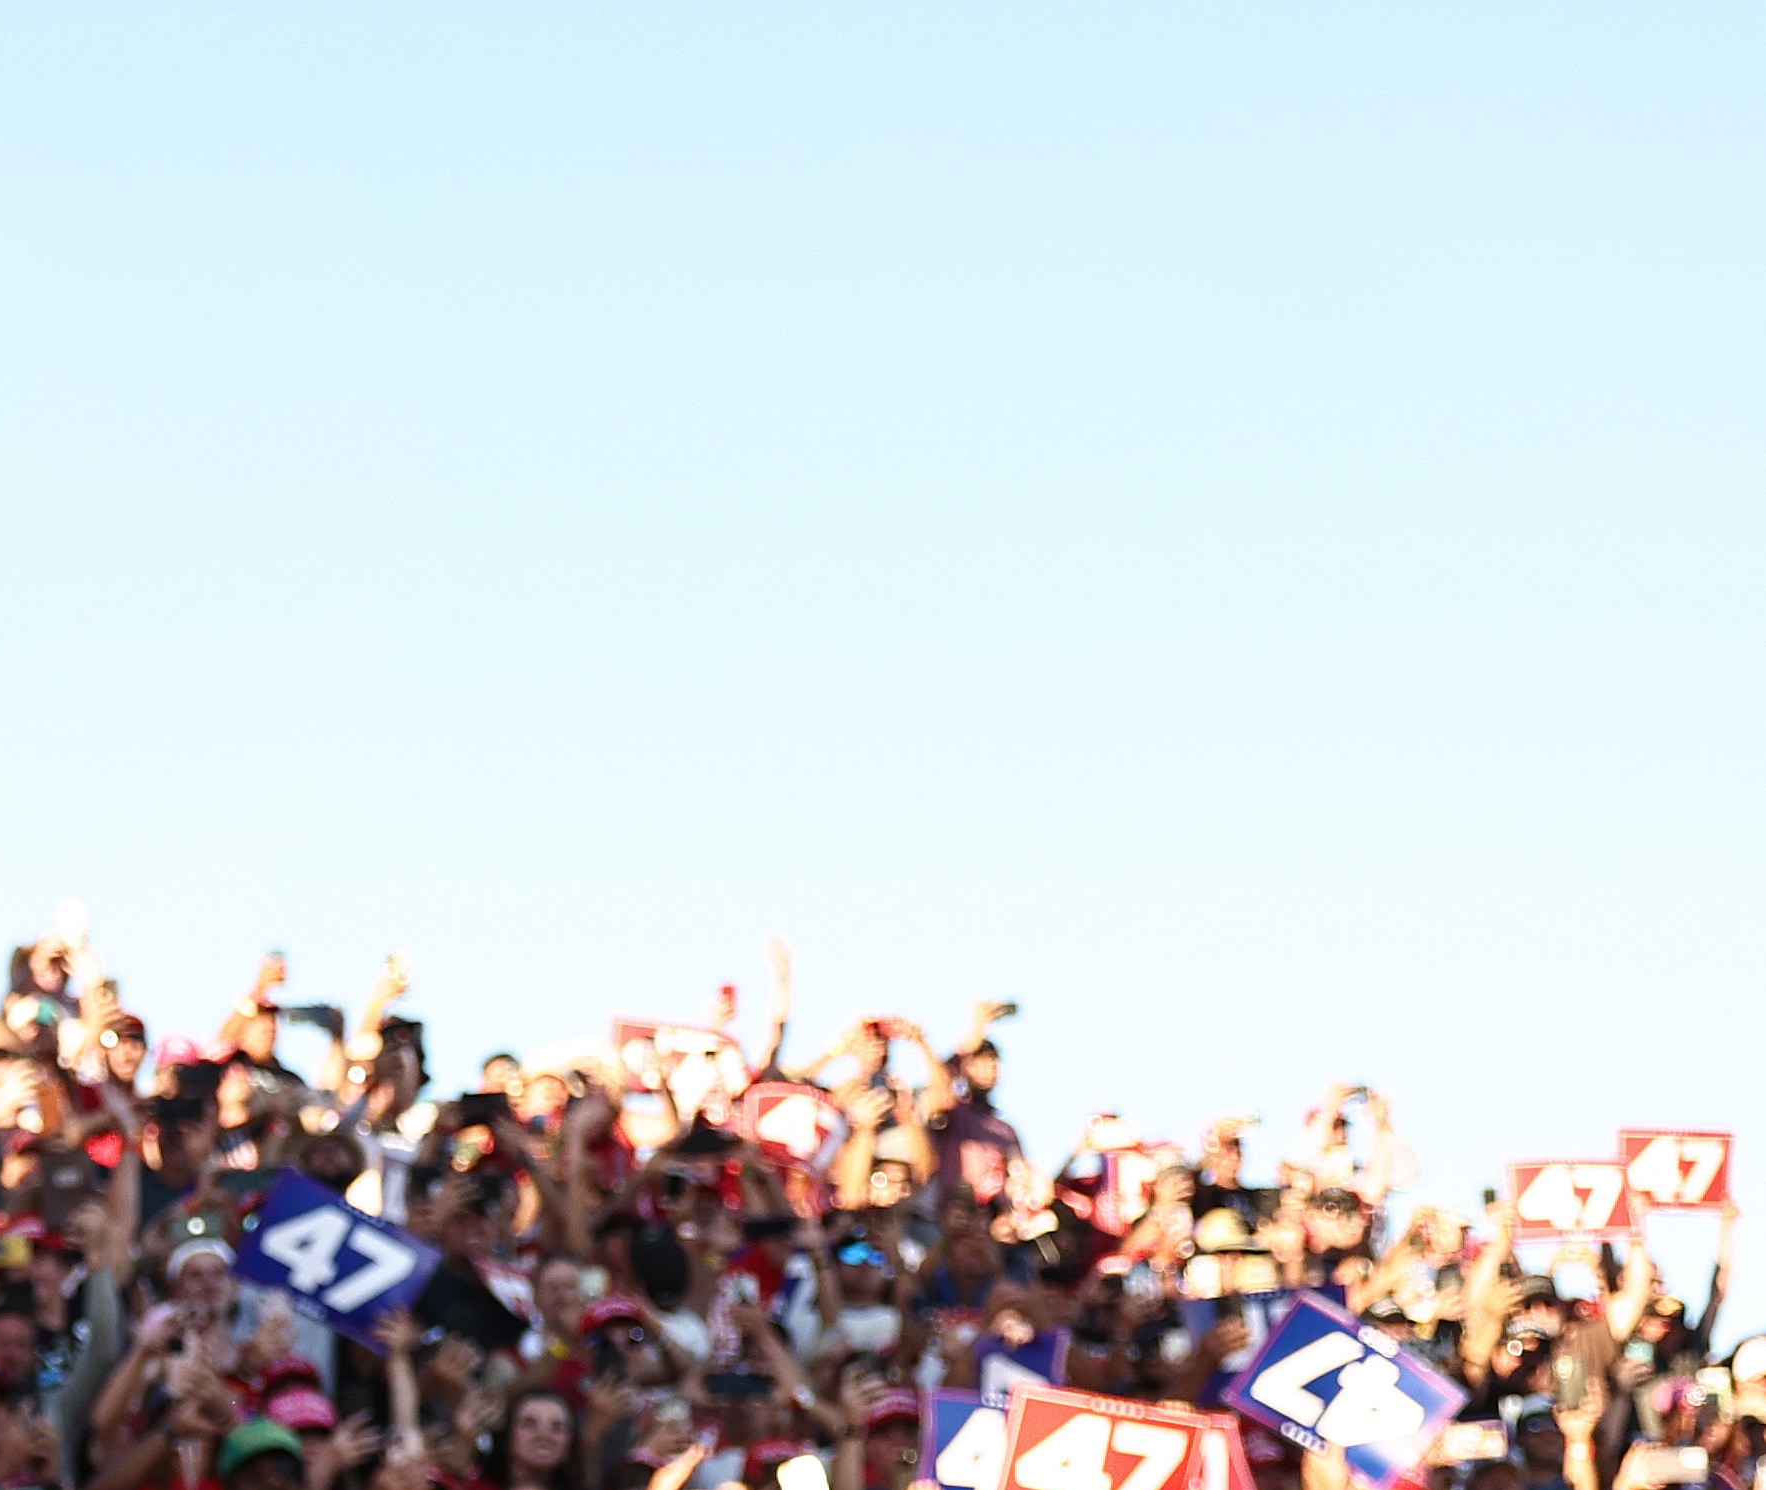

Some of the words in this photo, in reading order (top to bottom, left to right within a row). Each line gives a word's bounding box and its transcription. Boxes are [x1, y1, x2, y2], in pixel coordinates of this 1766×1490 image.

[1519, 1164, 1622, 1230] 47
[1628, 1136, 1725, 1203] 47
[261, 1206, 417, 1313] 47
